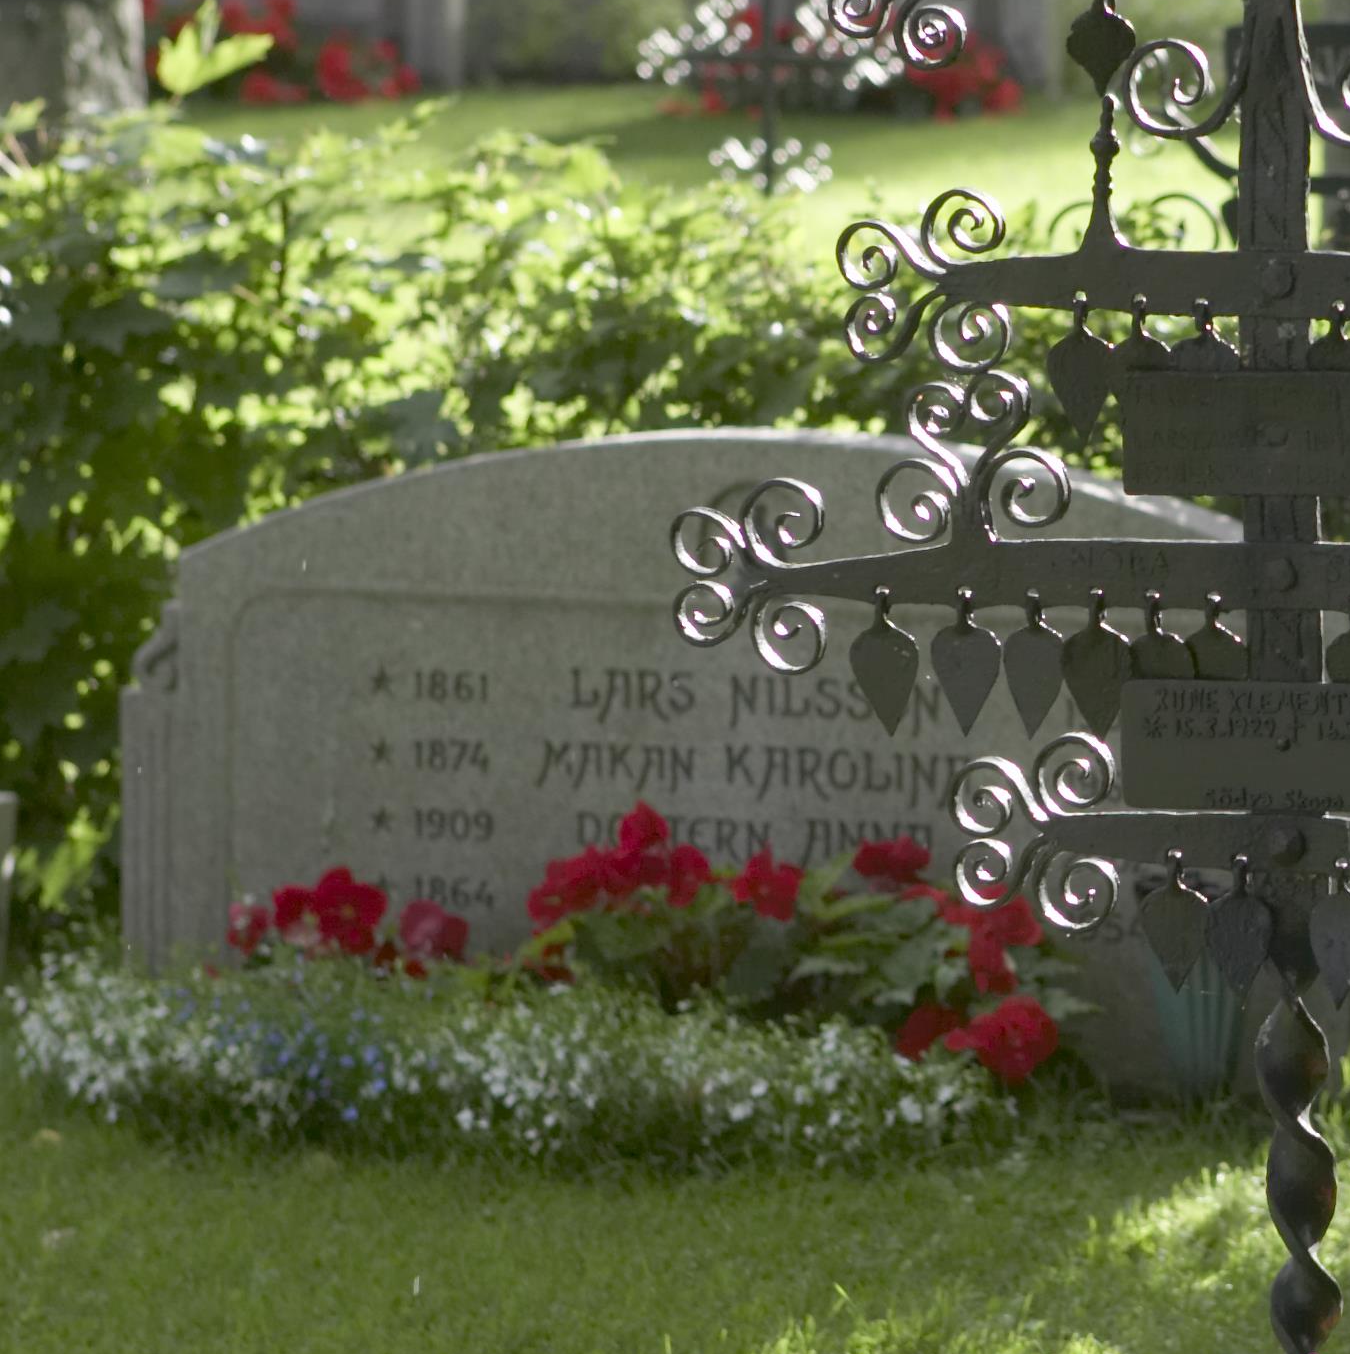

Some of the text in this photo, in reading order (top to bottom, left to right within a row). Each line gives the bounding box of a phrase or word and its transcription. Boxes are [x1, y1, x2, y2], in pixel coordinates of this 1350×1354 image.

[413, 667, 941, 738] 1861 LARS NILSSN
[1154, 690, 1219, 714] RUNE
[413, 738, 489, 774] 1874
[533, 739, 694, 794] MAKAN
[413, 807, 495, 842] 1909
[576, 810, 771, 865] DTERN
[414, 873, 495, 909] 1864
